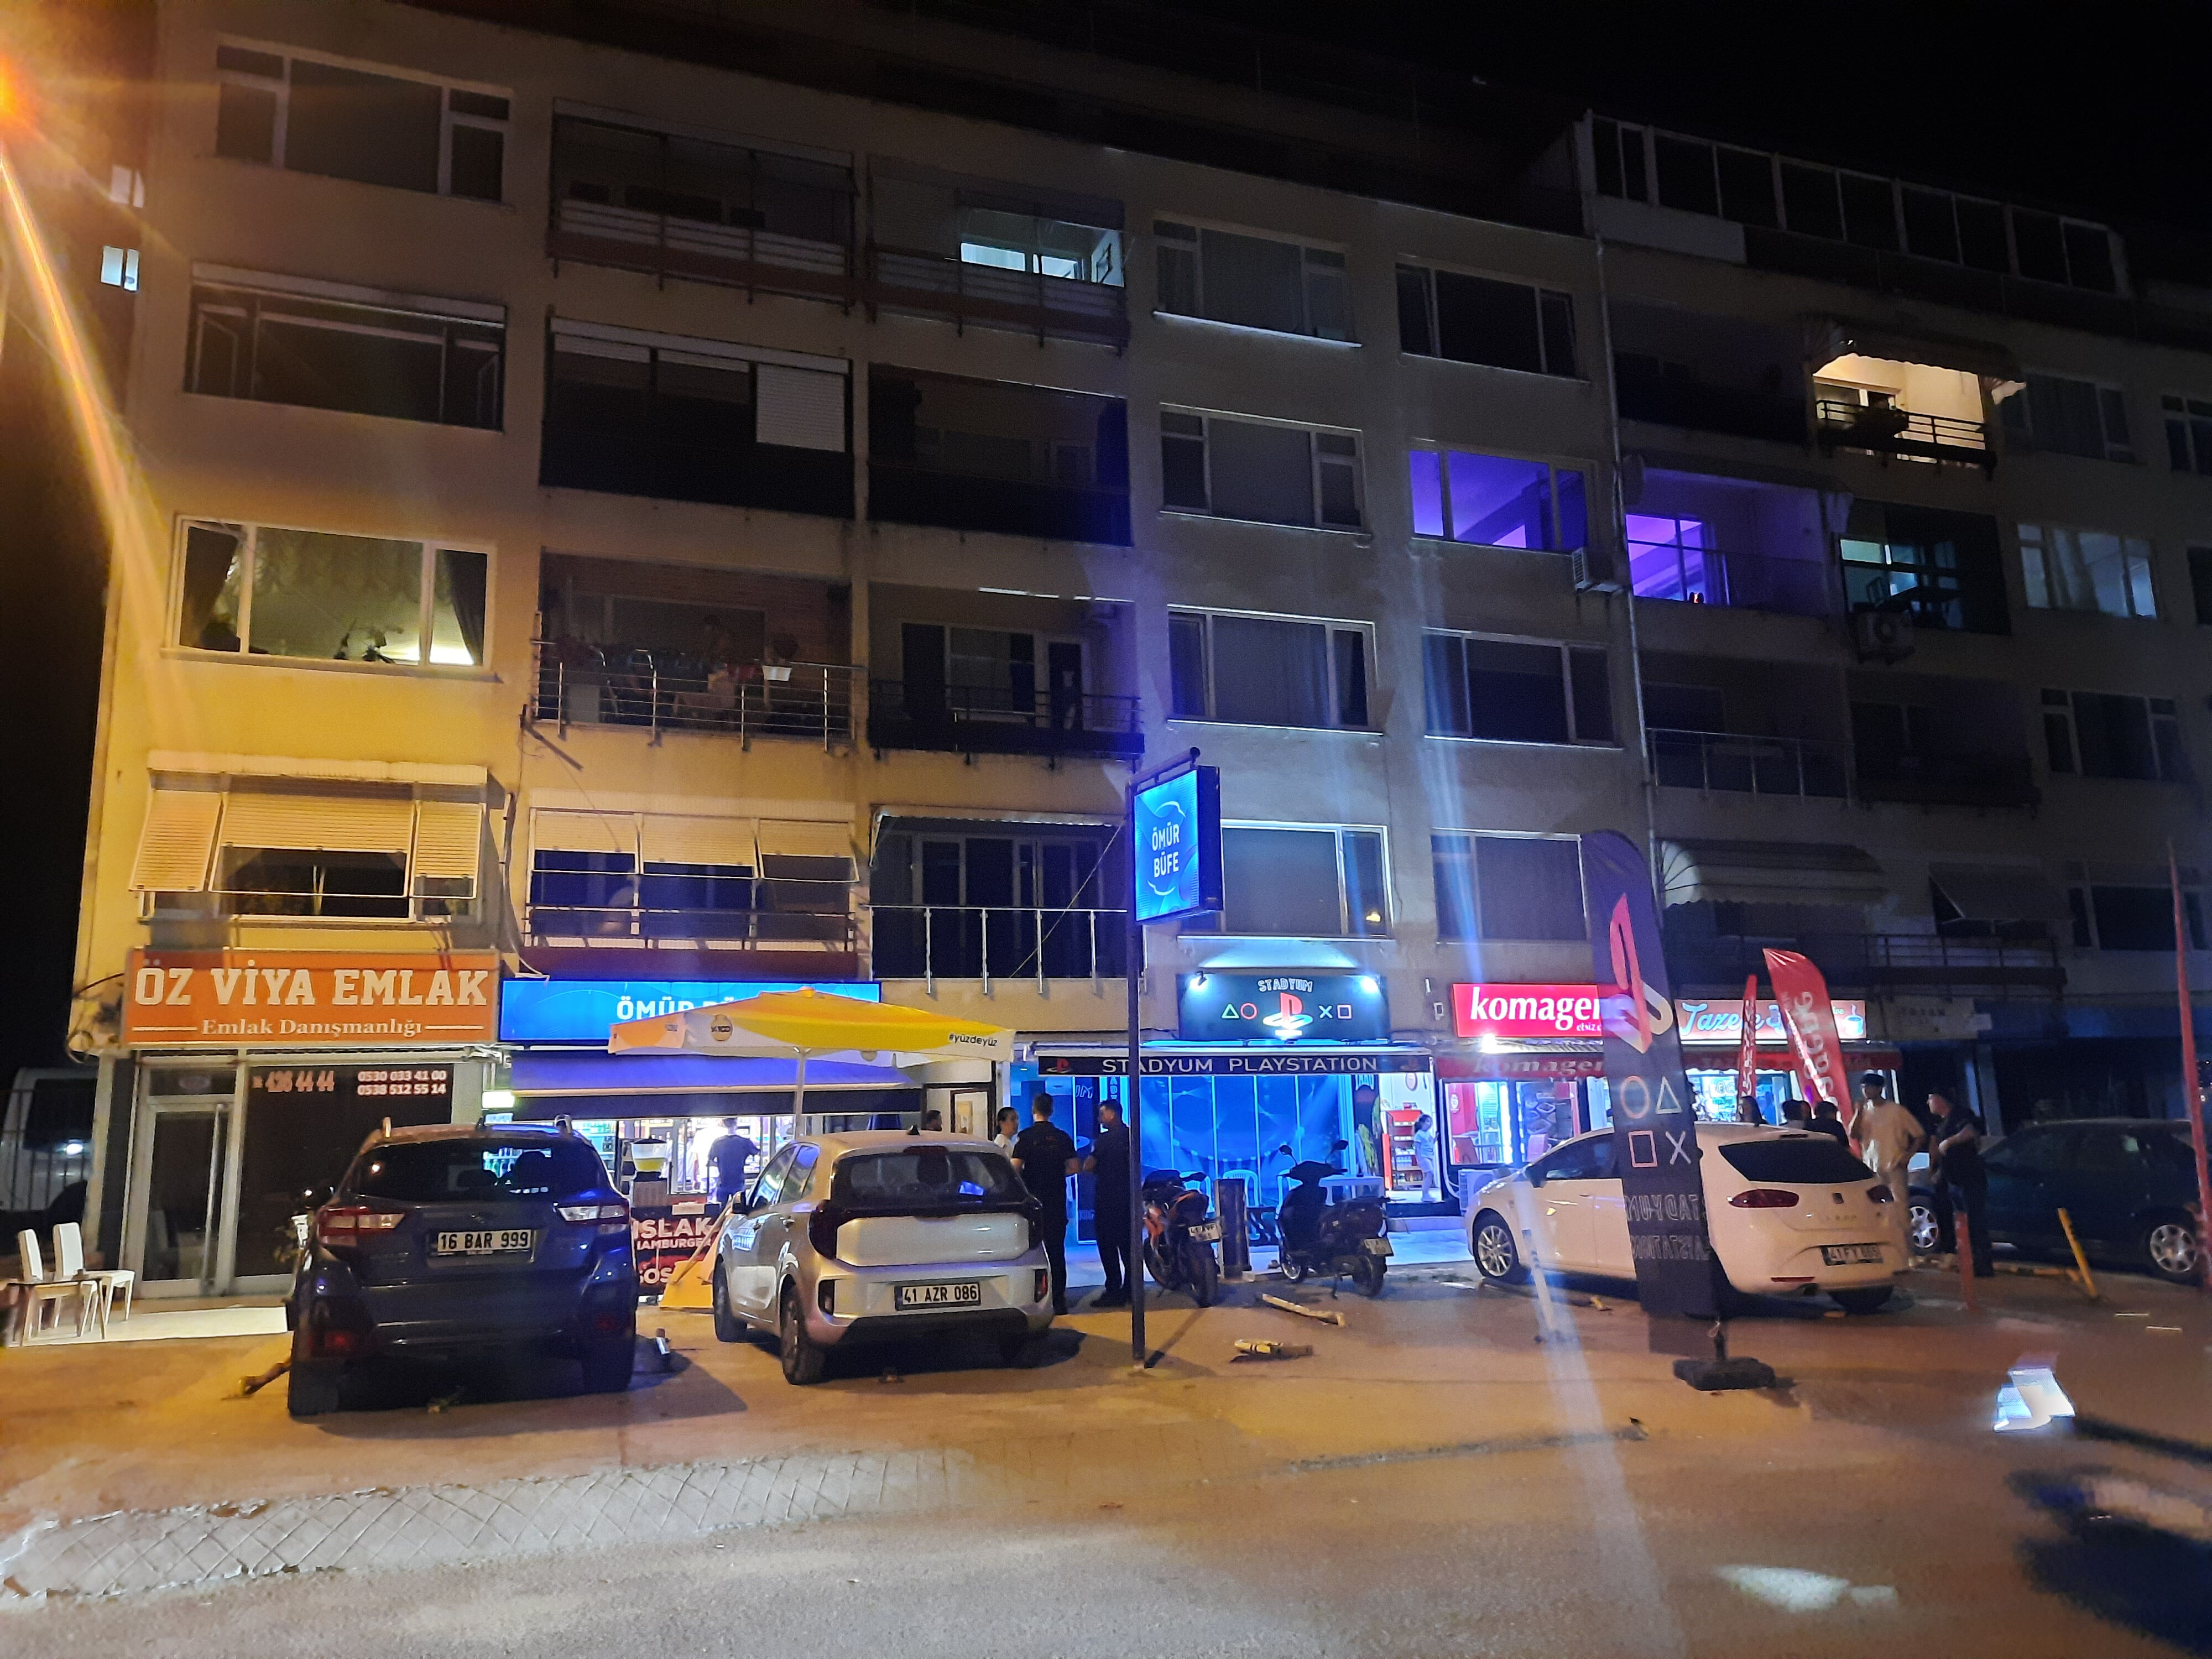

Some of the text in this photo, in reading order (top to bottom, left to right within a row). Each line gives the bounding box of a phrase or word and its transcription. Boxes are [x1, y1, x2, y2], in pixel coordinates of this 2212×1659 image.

[1152, 821, 1180, 851] ÖMÜR
[1154, 851, 1179, 878] BÜFE
[135, 959, 488, 1005] ÖZ VİYA EMLAK
[1258, 978, 1313, 993] STADYUM
[202, 1018, 422, 1037] Emlak Danışmanlığı
[949, 1032, 998, 1047] #yüzdeyüz
[1228, 1057, 1377, 1071] PLAYSTATION
[414, 1070, 430, 1081] 41
[414, 1084, 430, 1095] 55
[431, 1083, 447, 1095] 14
[441, 1232, 529, 1250] 16 BAR 999
[904, 1285, 977, 1303] 41 AZR 086
